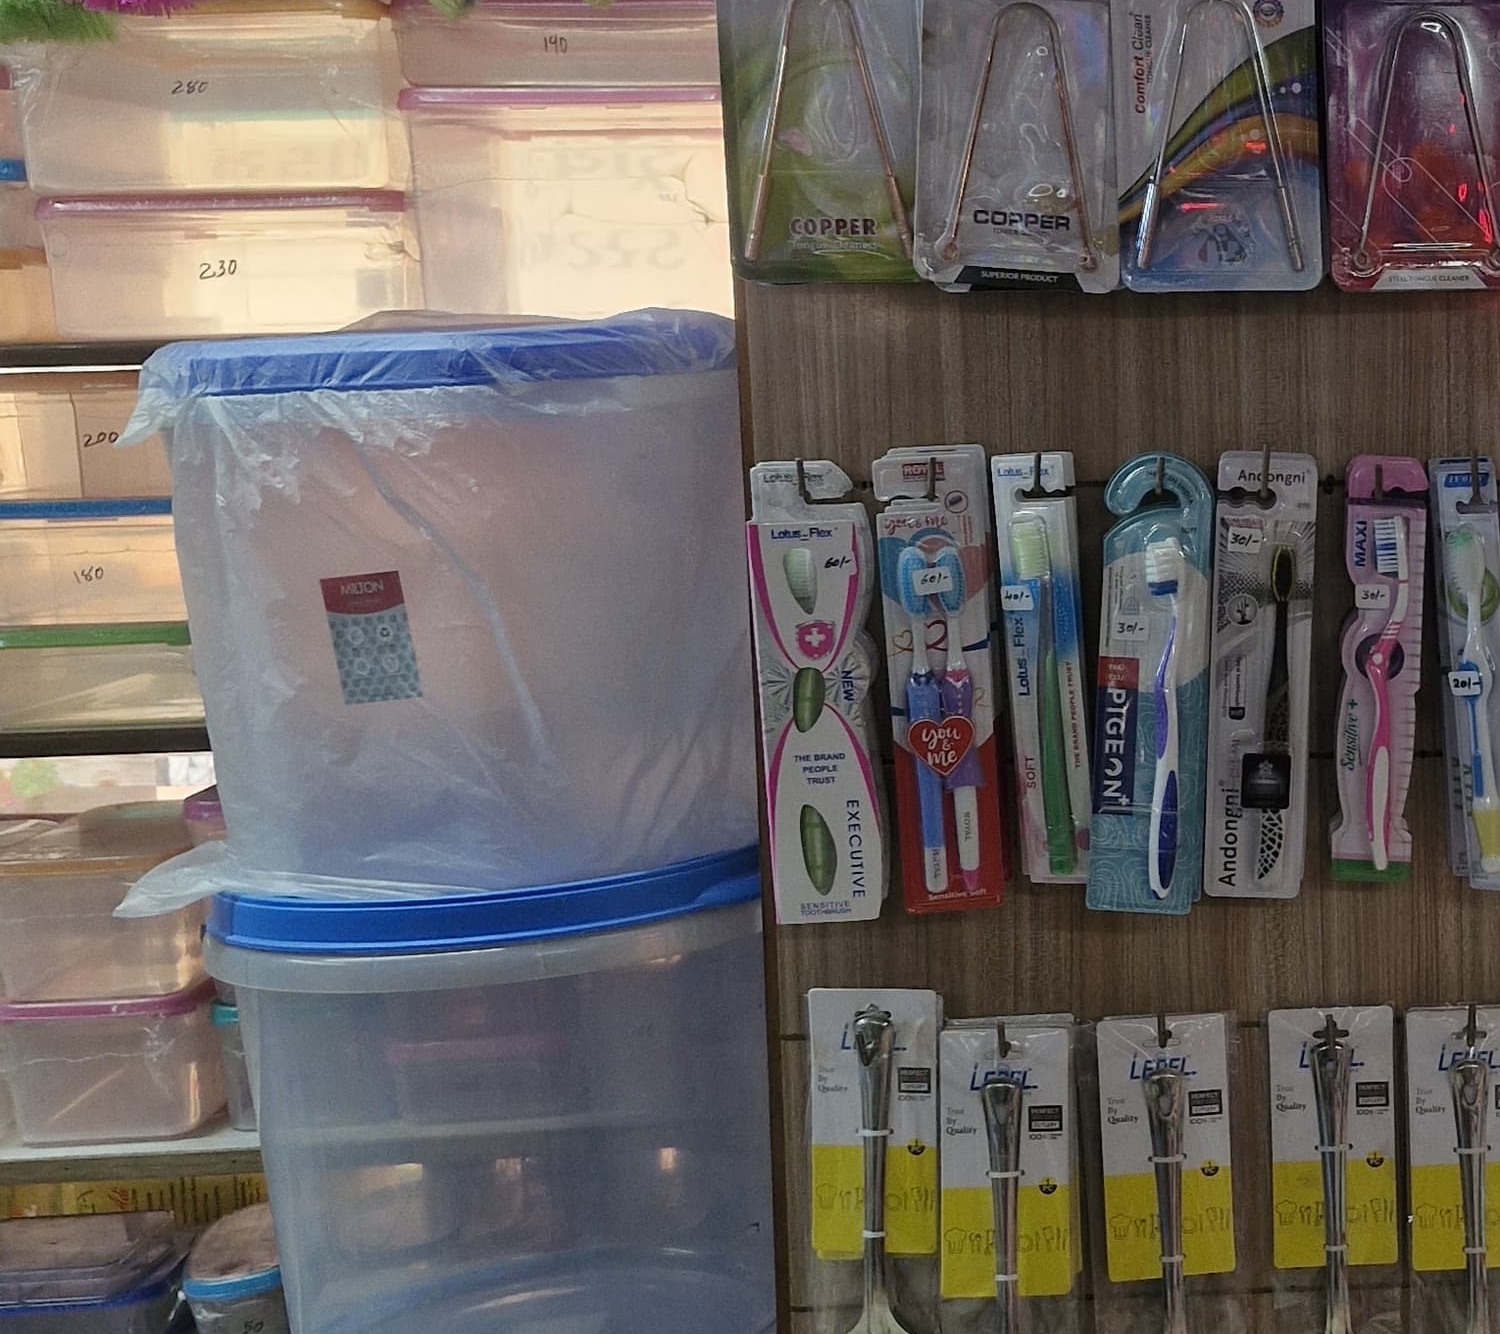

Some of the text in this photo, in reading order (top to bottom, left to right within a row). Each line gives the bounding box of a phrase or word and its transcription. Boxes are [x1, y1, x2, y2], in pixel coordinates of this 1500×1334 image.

[1133, 14, 1146, 114] Comfort Clean
[171, 81, 208, 95] 280
[790, 218, 876, 236] COPPER
[974, 210, 1070, 231] COPPER
[199, 259, 237, 279] 230
[981, 270, 1058, 284] SUPERIOR PRODUCT
[84, 431, 119, 448] 200
[1230, 533, 1260, 545] 30/-
[1354, 520, 1367, 567] MAXI
[73, 566, 104, 583] 180
[341, 579, 384, 596] MILTON
[1362, 590, 1385, 601] 30/-
[1117, 622, 1144, 635] 30/-
[841, 670, 855, 701] NEW
[1453, 677, 1480, 688] 20/-
[922, 726, 961, 746] you
[1341, 713, 1358, 771] Sensitive
[794, 753, 846, 762] THE BRAND
[928, 752, 958, 766] me
[802, 765, 838, 773] PEOPLE
[1026, 757, 1037, 789] SOFT
[807, 776, 835, 785] TRUST
[1219, 787, 1242, 886] Andongni
[846, 800, 866, 898] EXECUTIVE
